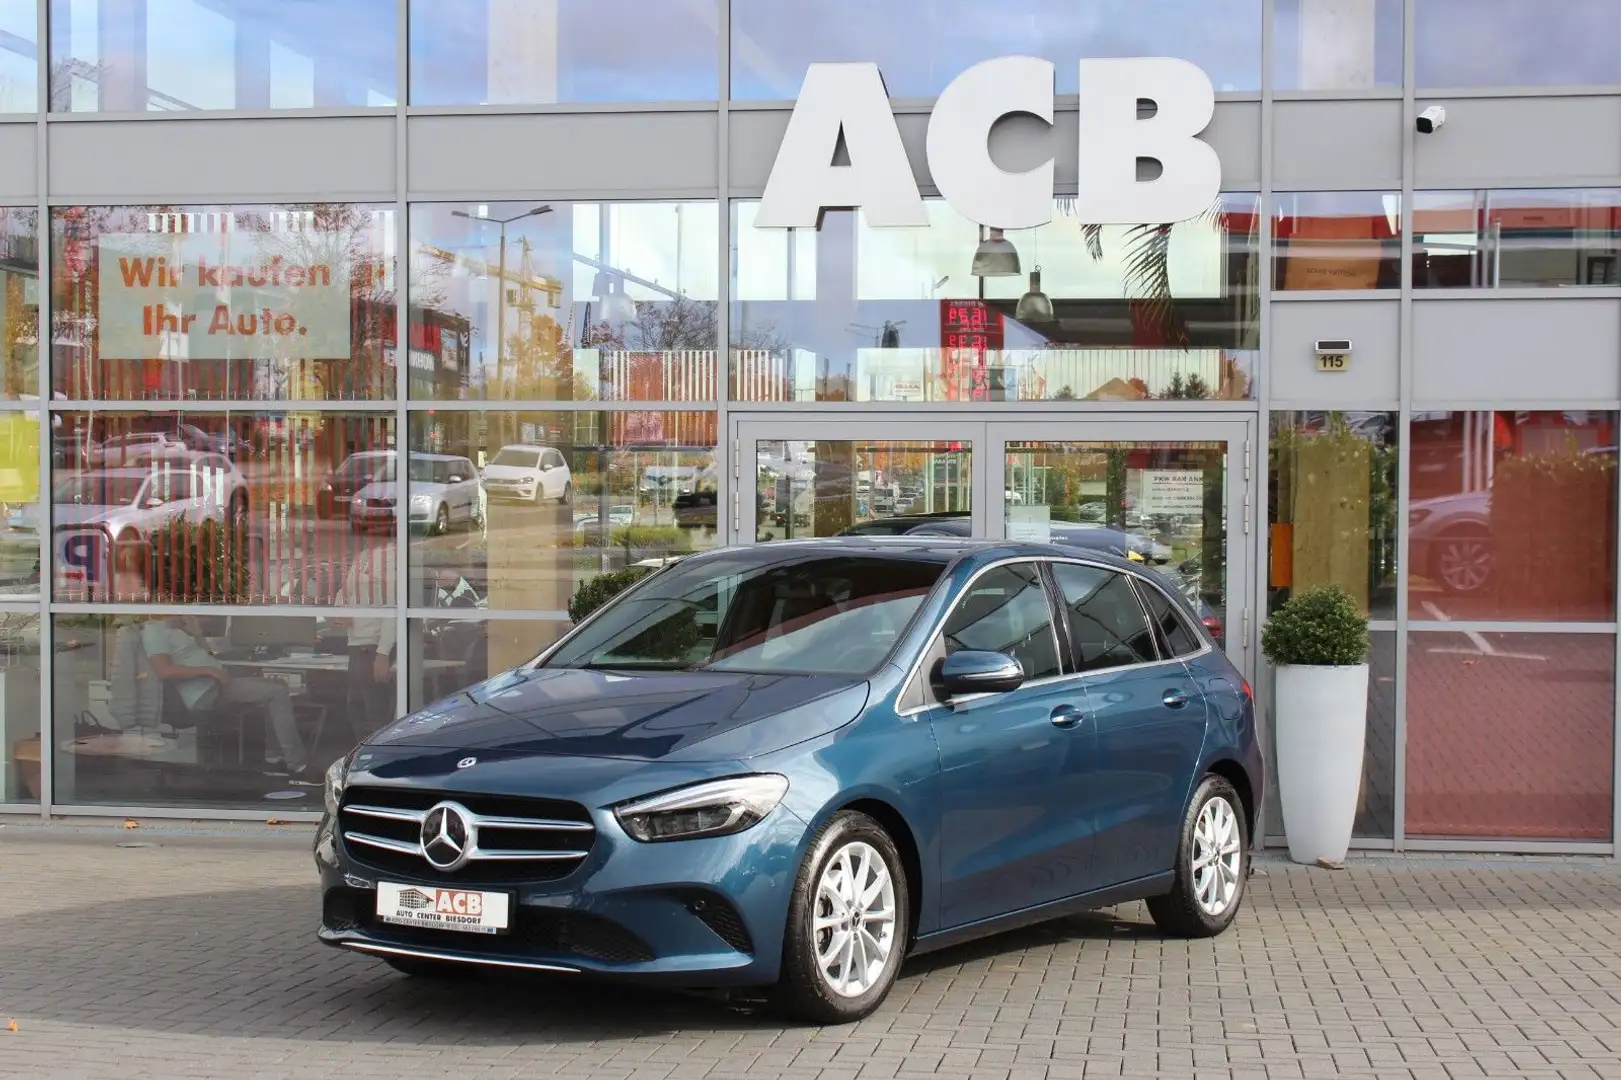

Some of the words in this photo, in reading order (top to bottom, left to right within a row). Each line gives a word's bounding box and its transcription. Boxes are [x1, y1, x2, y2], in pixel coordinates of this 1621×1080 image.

[753, 55, 1222, 230] ACB
[118, 256, 184, 288] Wir
[198, 254, 332, 288] kaufen
[143, 303, 196, 335] Ihr
[207, 304, 307, 336] Auto.
[1320, 355, 1344, 368] 115
[396, 909, 414, 918] AUTO
[416, 911, 441, 921] CENTER
[445, 915, 482, 925] BIESDORF
[436, 890, 483, 915] ACB
